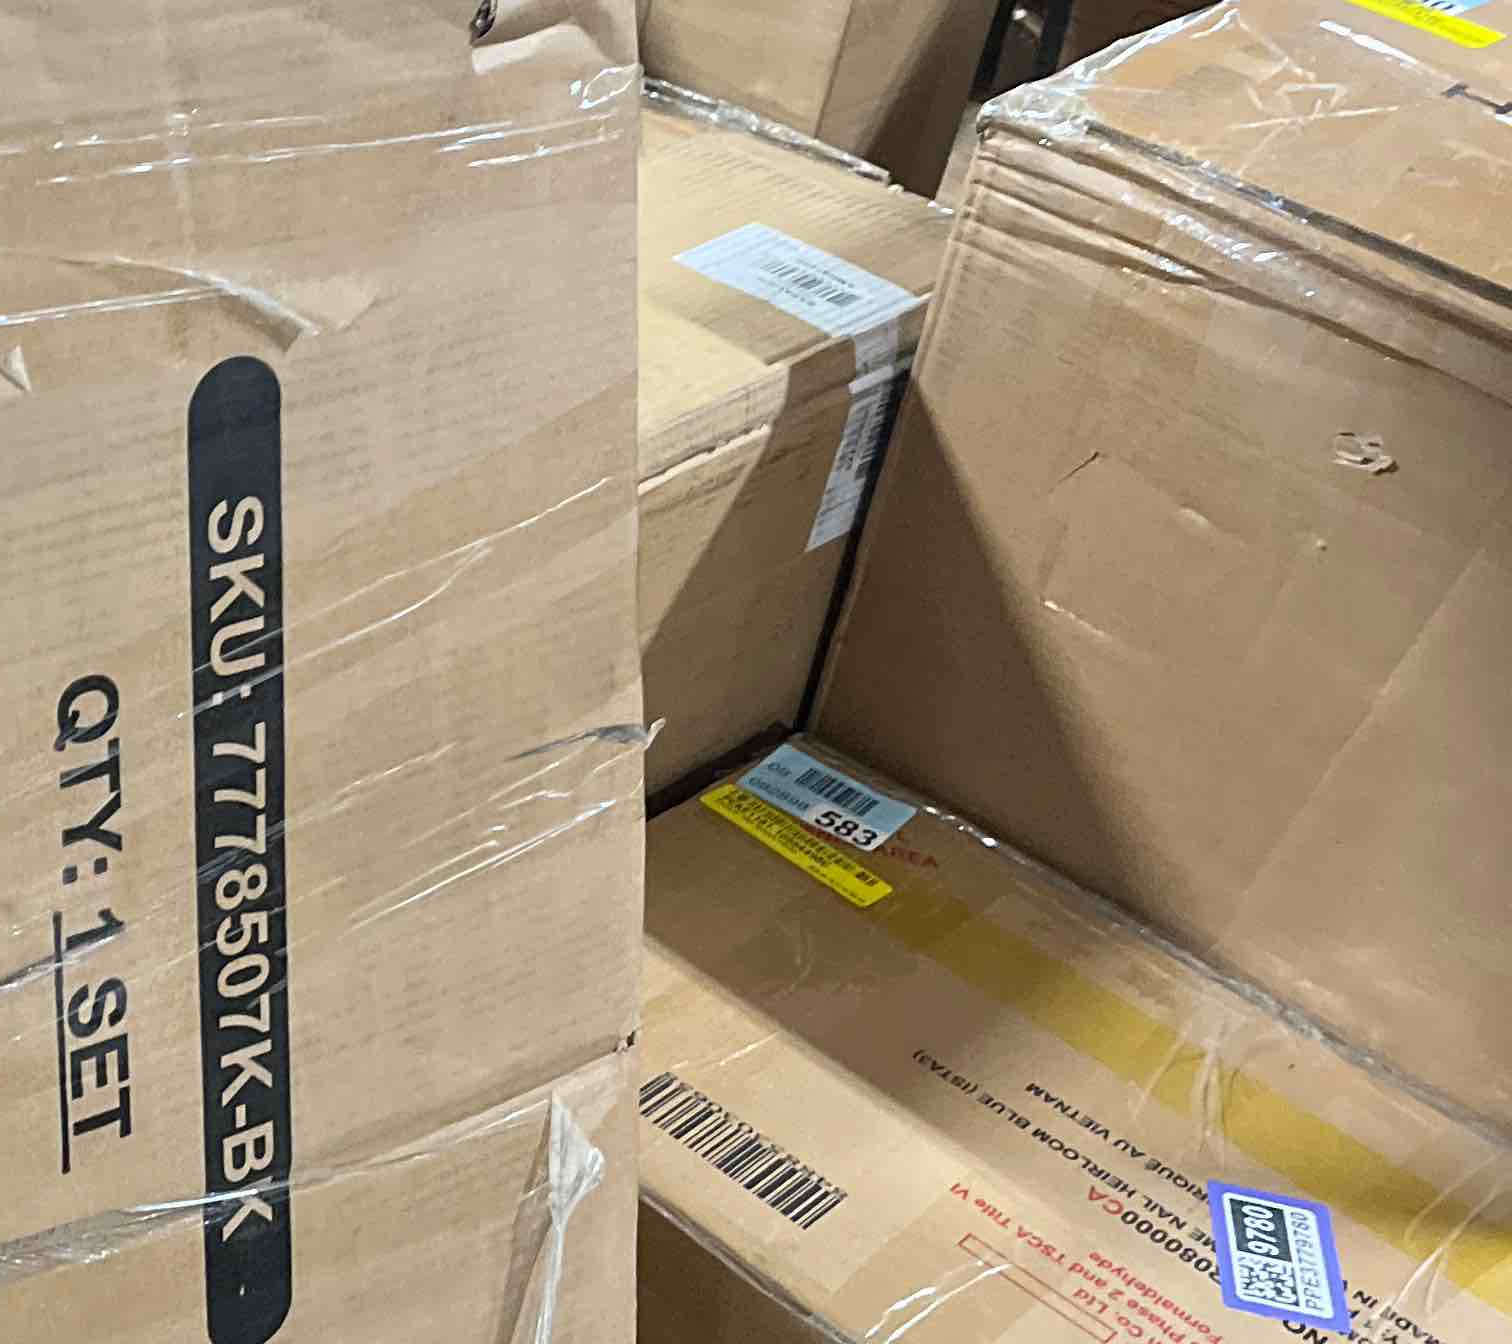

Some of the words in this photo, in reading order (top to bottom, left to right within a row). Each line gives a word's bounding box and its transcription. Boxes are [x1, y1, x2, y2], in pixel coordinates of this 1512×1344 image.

[207, 496, 266, 706] SKU:
[52, 674, 123, 885] QTY:
[813, 809, 879, 848] 583
[65, 908, 125, 952] 1
[210, 722, 277, 1242] 7778507K-BK
[67, 976, 132, 1138] SET
[1025, 1084, 1110, 1141] VIETNAM
[1032, 1129, 1137, 1198] HEIRLOOM
[1112, 1139, 1146, 1158] AU
[1143, 1195, 1187, 1230] NAIL
[1240, 1205, 1280, 1256] 9780
[1068, 1263, 1107, 1288] and
[1089, 1253, 1223, 1344] Formaldehyde
[1073, 1288, 1109, 1314] Ltd
[1127, 1300, 1186, 1344] Phase
[1352, 1290, 1378, 1309] IN
